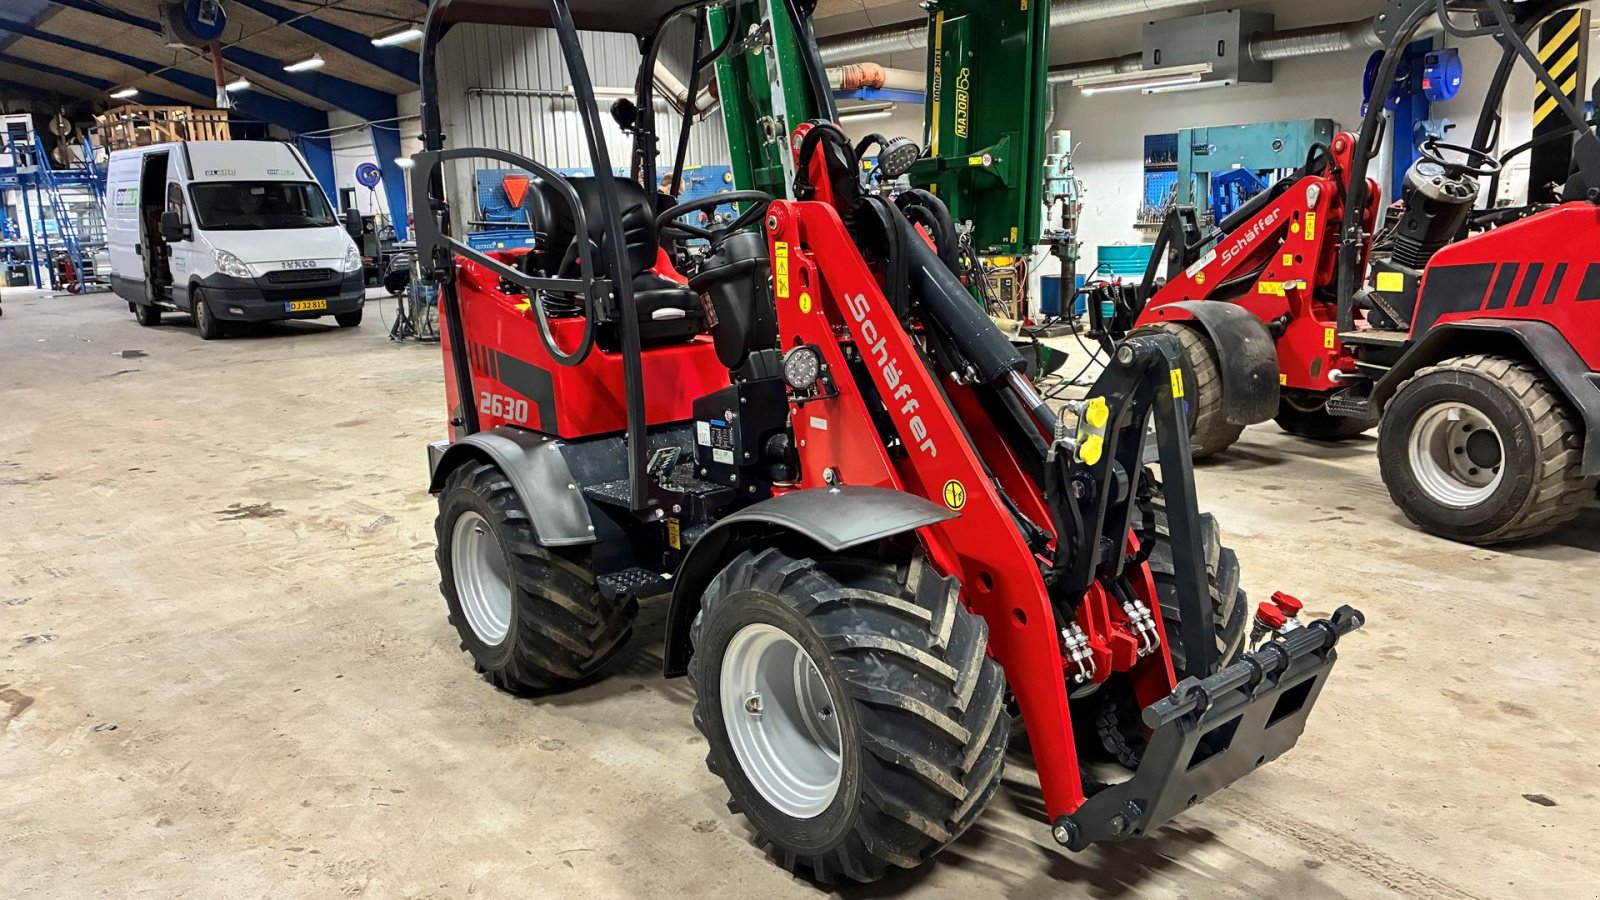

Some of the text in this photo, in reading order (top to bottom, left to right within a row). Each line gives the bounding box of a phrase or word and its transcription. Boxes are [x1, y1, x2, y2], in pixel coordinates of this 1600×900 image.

[957, 93, 968, 135] MAJOR
[1221, 208, 1280, 267] Schäffer
[844, 292, 938, 458] Schäffer
[480, 391, 528, 423] 2630
